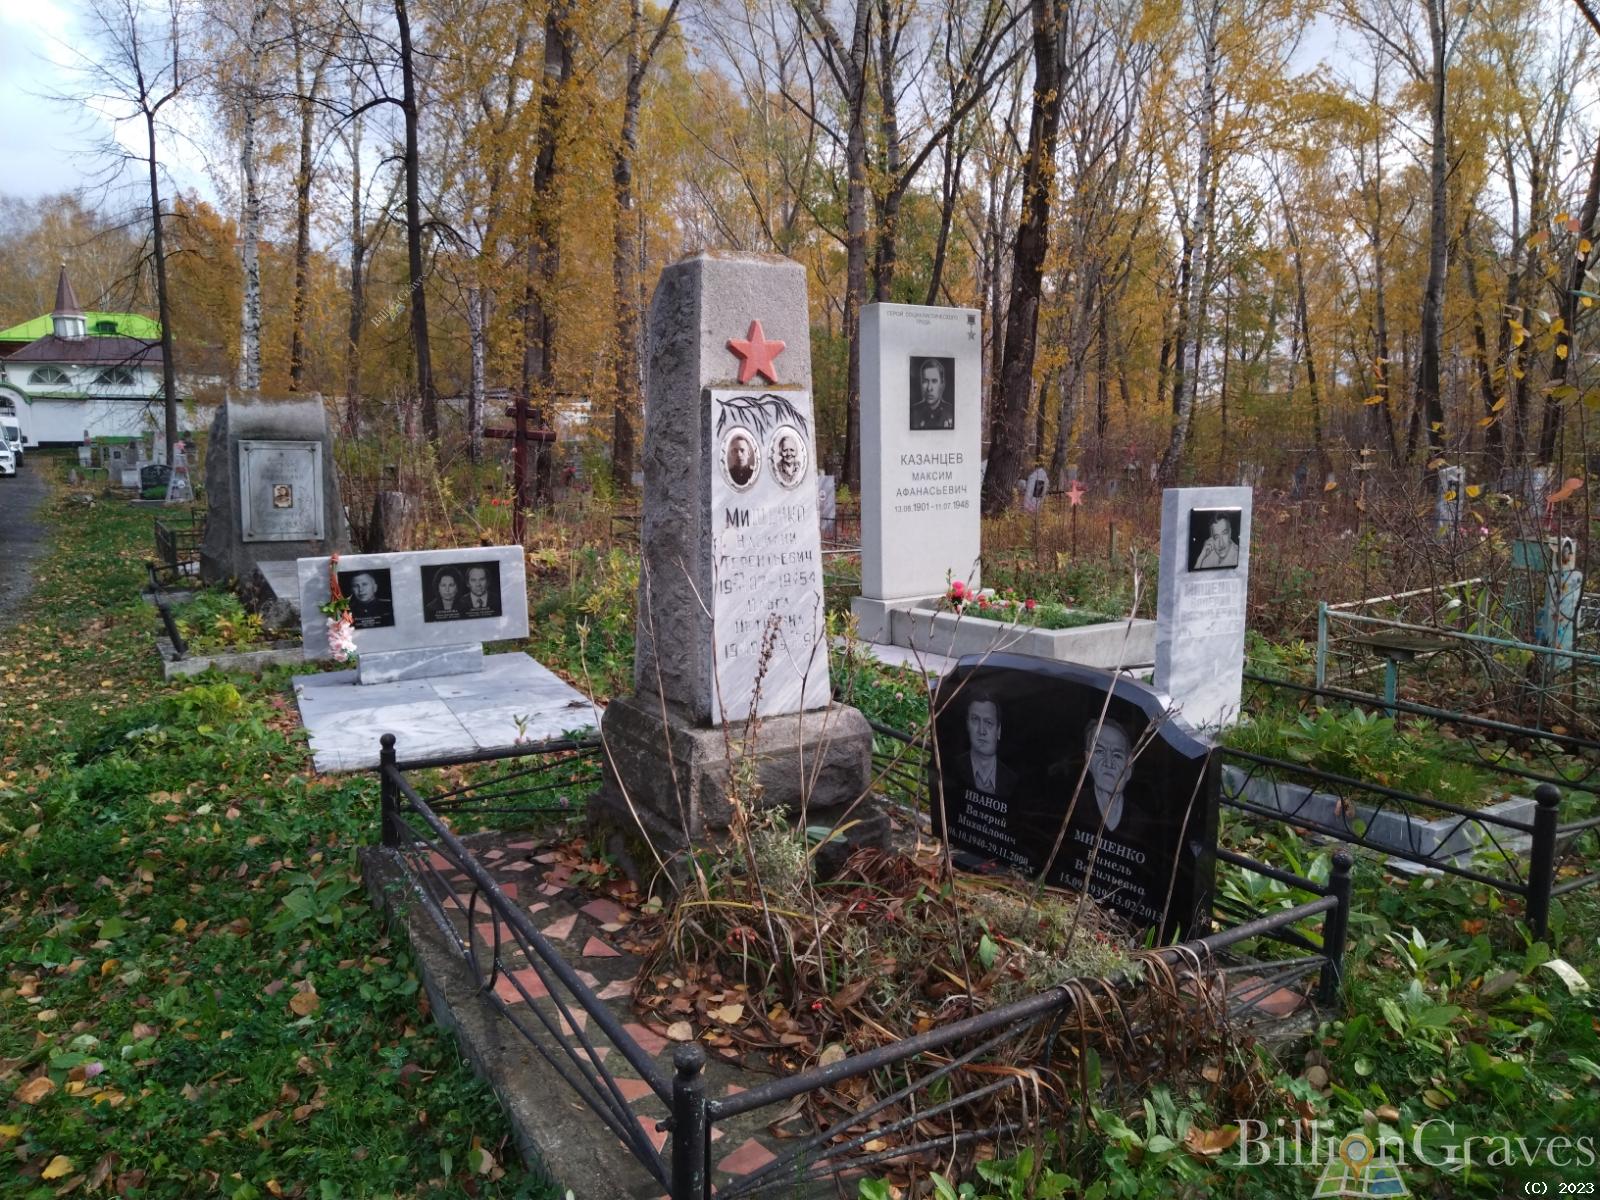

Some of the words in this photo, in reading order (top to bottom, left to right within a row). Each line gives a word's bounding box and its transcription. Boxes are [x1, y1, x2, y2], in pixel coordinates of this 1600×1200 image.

[900, 452, 964, 467] КАЗАНЦЕВ
[911, 471, 953, 481] МАКСИМ
[895, 484, 968, 498] АФАНАСЬЕВИЧ
[964, 788, 1008, 814] ИВАНОВ
[957, 812, 1017, 846] Михайлович
[965, 803, 1007, 829] Валерий
[1073, 828, 1146, 864] МИЩЕНКО
